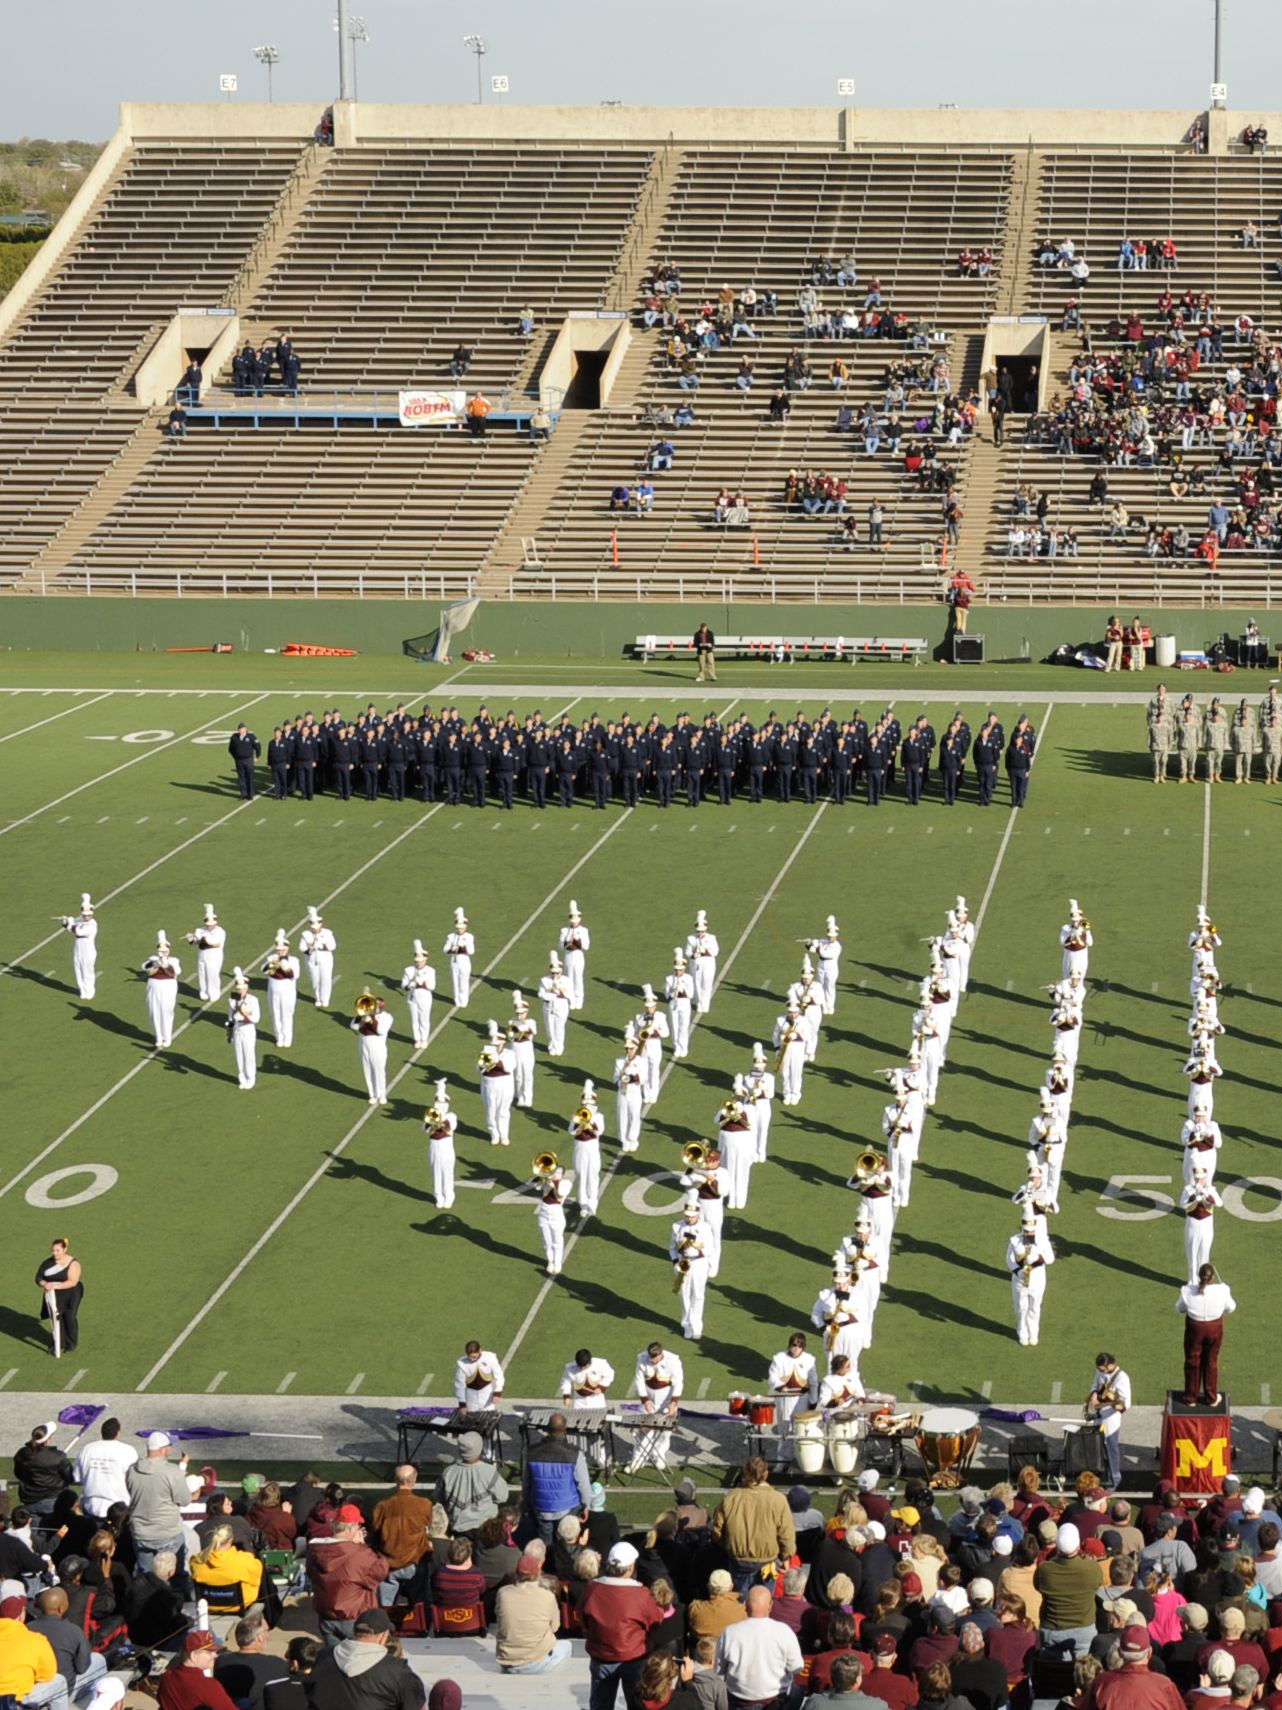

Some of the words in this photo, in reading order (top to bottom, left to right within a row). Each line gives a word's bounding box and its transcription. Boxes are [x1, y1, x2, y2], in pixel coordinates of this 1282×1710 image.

[222, 78, 236, 89] E7
[494, 79, 507, 89] E6
[840, 82, 853, 92] E5
[1212, 86, 1225, 97] E4
[1175, 1438, 1228, 1477] M
[444, 1608, 473, 1623] MSU
